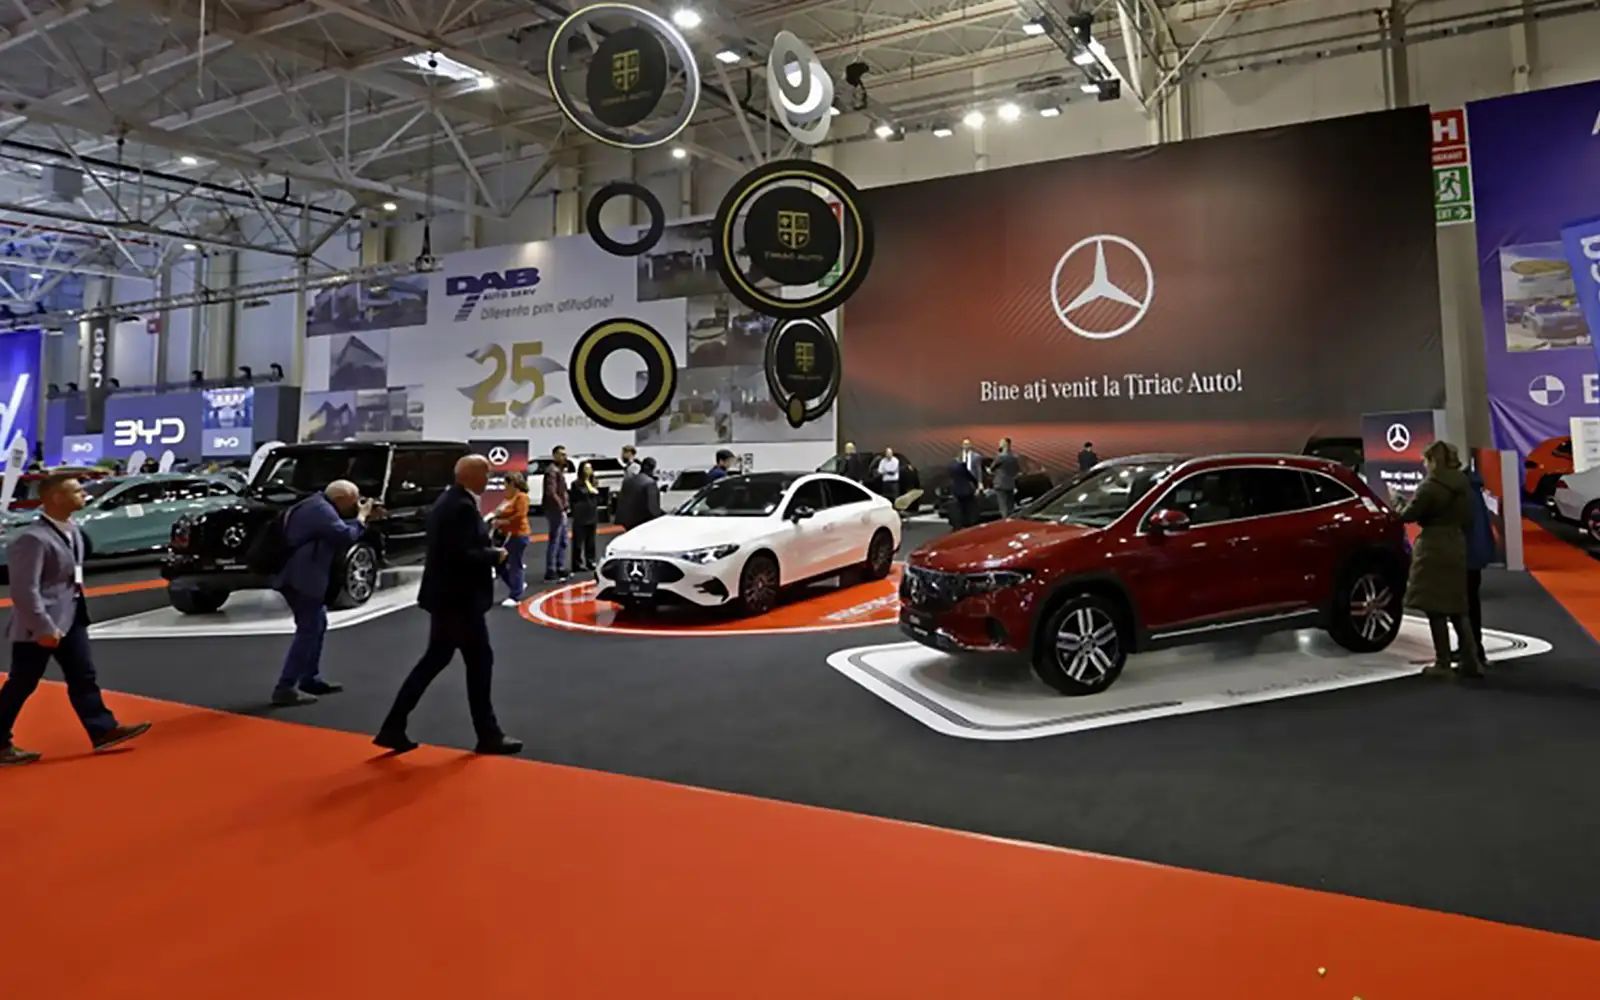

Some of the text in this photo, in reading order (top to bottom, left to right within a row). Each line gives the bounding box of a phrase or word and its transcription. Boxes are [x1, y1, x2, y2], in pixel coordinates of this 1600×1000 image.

[1432, 118, 1458, 142] H
[446, 267, 541, 296] DAB
[90, 328, 106, 388] Jeep
[467, 340, 545, 417] 25
[980, 380, 1020, 402] Bine
[1051, 376, 1099, 399] venit
[1103, 374, 1121, 397] la
[1187, 369, 1243, 394] Auto!
[113, 416, 186, 447] BYD
[213, 436, 240, 449] BYD
